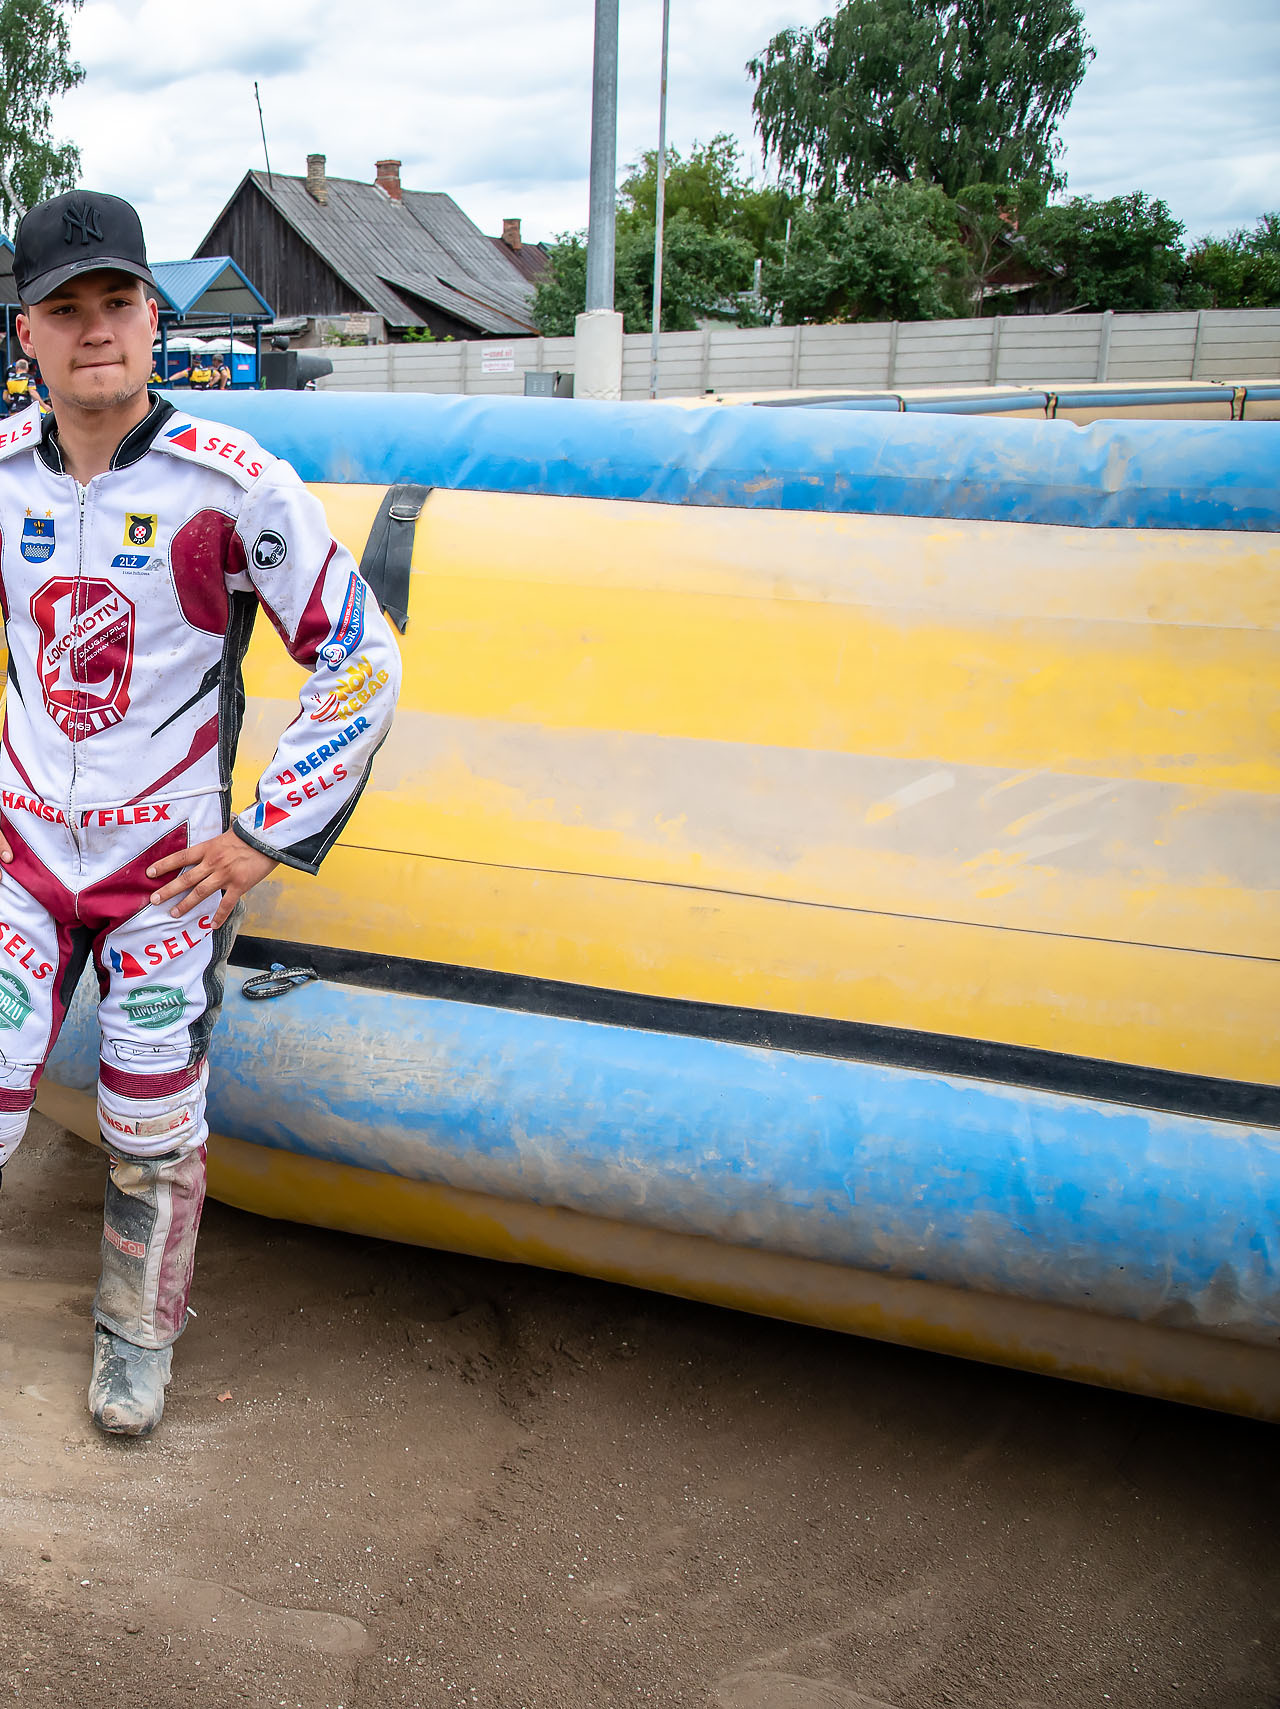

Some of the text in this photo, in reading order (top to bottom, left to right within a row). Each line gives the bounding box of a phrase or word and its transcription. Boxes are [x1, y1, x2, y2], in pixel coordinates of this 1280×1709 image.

[203, 437, 263, 478] SELS
[119, 555, 138, 567] 2LŻ
[46, 597, 119, 667] LOKOMOTIV
[343, 579, 362, 646] GRAND AUTO
[78, 620, 128, 659] DAUGAVPILS
[79, 631, 126, 668] SPEEDWAY CLUB
[337, 669, 389, 721] KEBAB
[293, 715, 372, 778] BERNER
[286, 763, 348, 808] SELS
[1, 790, 171, 829] HANSA FLEX
[144, 915, 215, 966] SELS
